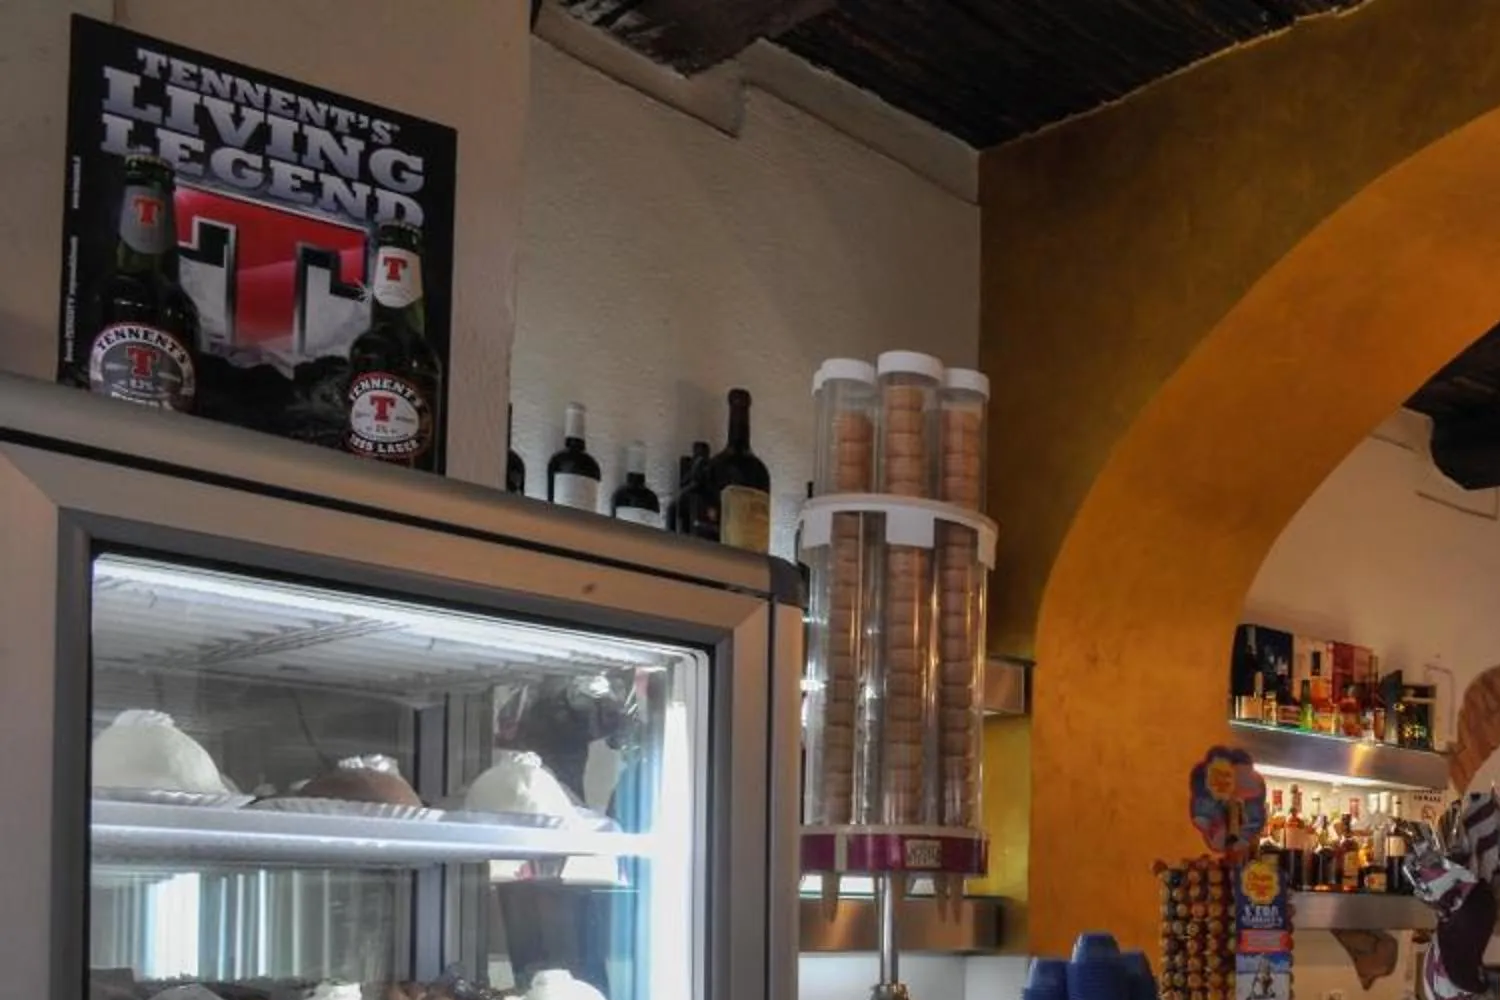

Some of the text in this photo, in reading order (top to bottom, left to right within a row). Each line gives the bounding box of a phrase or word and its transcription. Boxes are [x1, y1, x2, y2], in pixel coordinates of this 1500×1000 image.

[103, 66, 425, 194] LIVING
[137, 48, 393, 145] TENNENT'S
[101, 113, 425, 230] LEGEND
